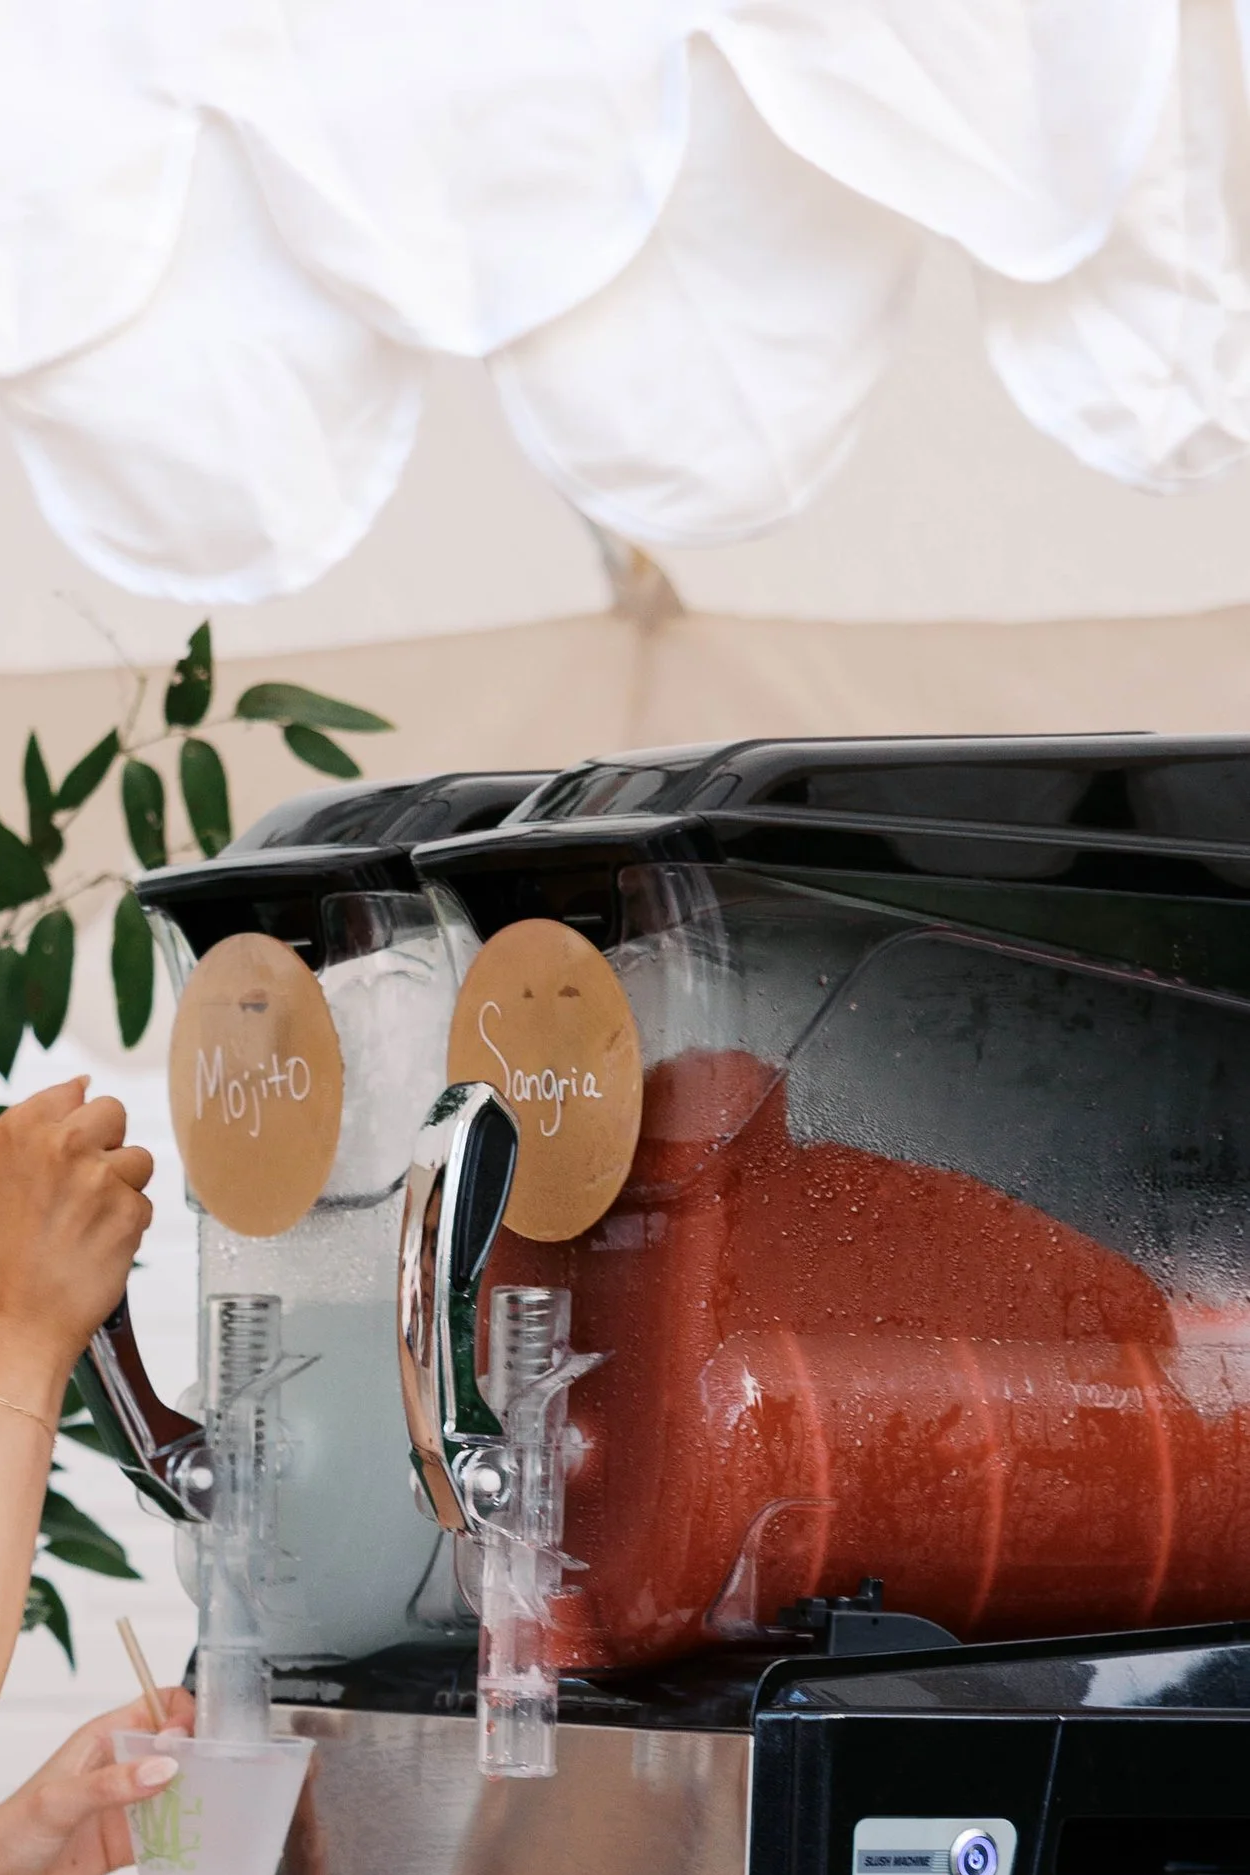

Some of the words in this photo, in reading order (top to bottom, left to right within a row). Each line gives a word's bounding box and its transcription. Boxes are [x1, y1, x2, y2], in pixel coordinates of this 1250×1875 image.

[195, 1044, 312, 1137] Mojito
[478, 1001, 603, 1136] Sangria
[893, 1855, 931, 1867] MACHINE
